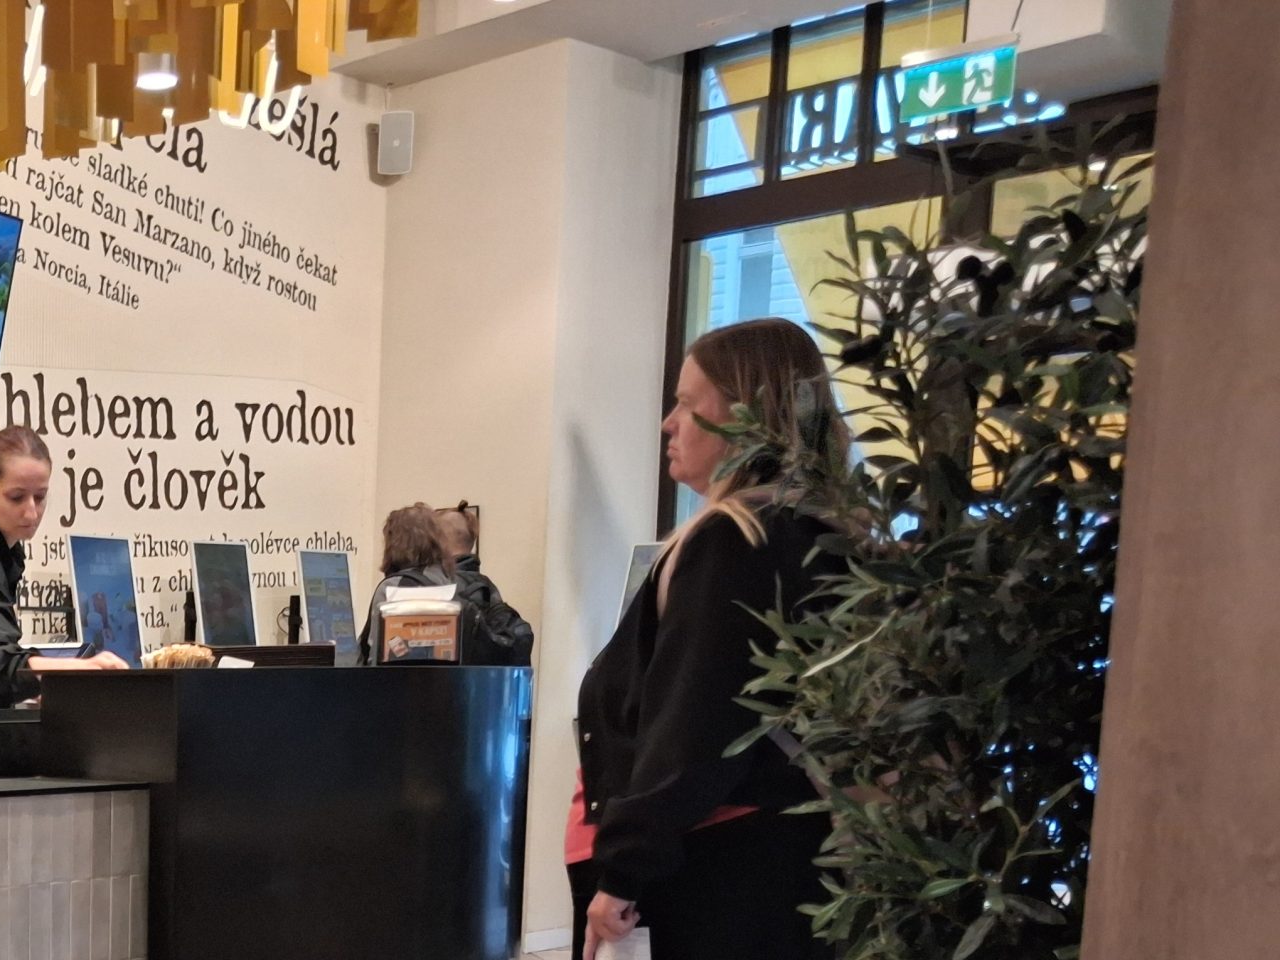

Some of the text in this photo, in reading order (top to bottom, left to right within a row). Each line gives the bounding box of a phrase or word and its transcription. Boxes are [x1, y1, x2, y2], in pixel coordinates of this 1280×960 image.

[26, 166, 84, 209] rajčat
[91, 190, 127, 228] San
[133, 208, 216, 270] Marzano,
[222, 247, 262, 287] když
[267, 274, 317, 312] rostou
[29, 201, 90, 251] kolem
[87, 153, 338, 286] sladké chuti! Co jiného čekat
[33, 248, 91, 295] Norcia,
[98, 274, 140, 310] Itálie
[194, 399, 219, 442] a
[235, 389, 356, 446] vodou
[59, 447, 266, 528] je člověk
[41, 534, 66, 567] jst
[306, 531, 358, 555] chleba,
